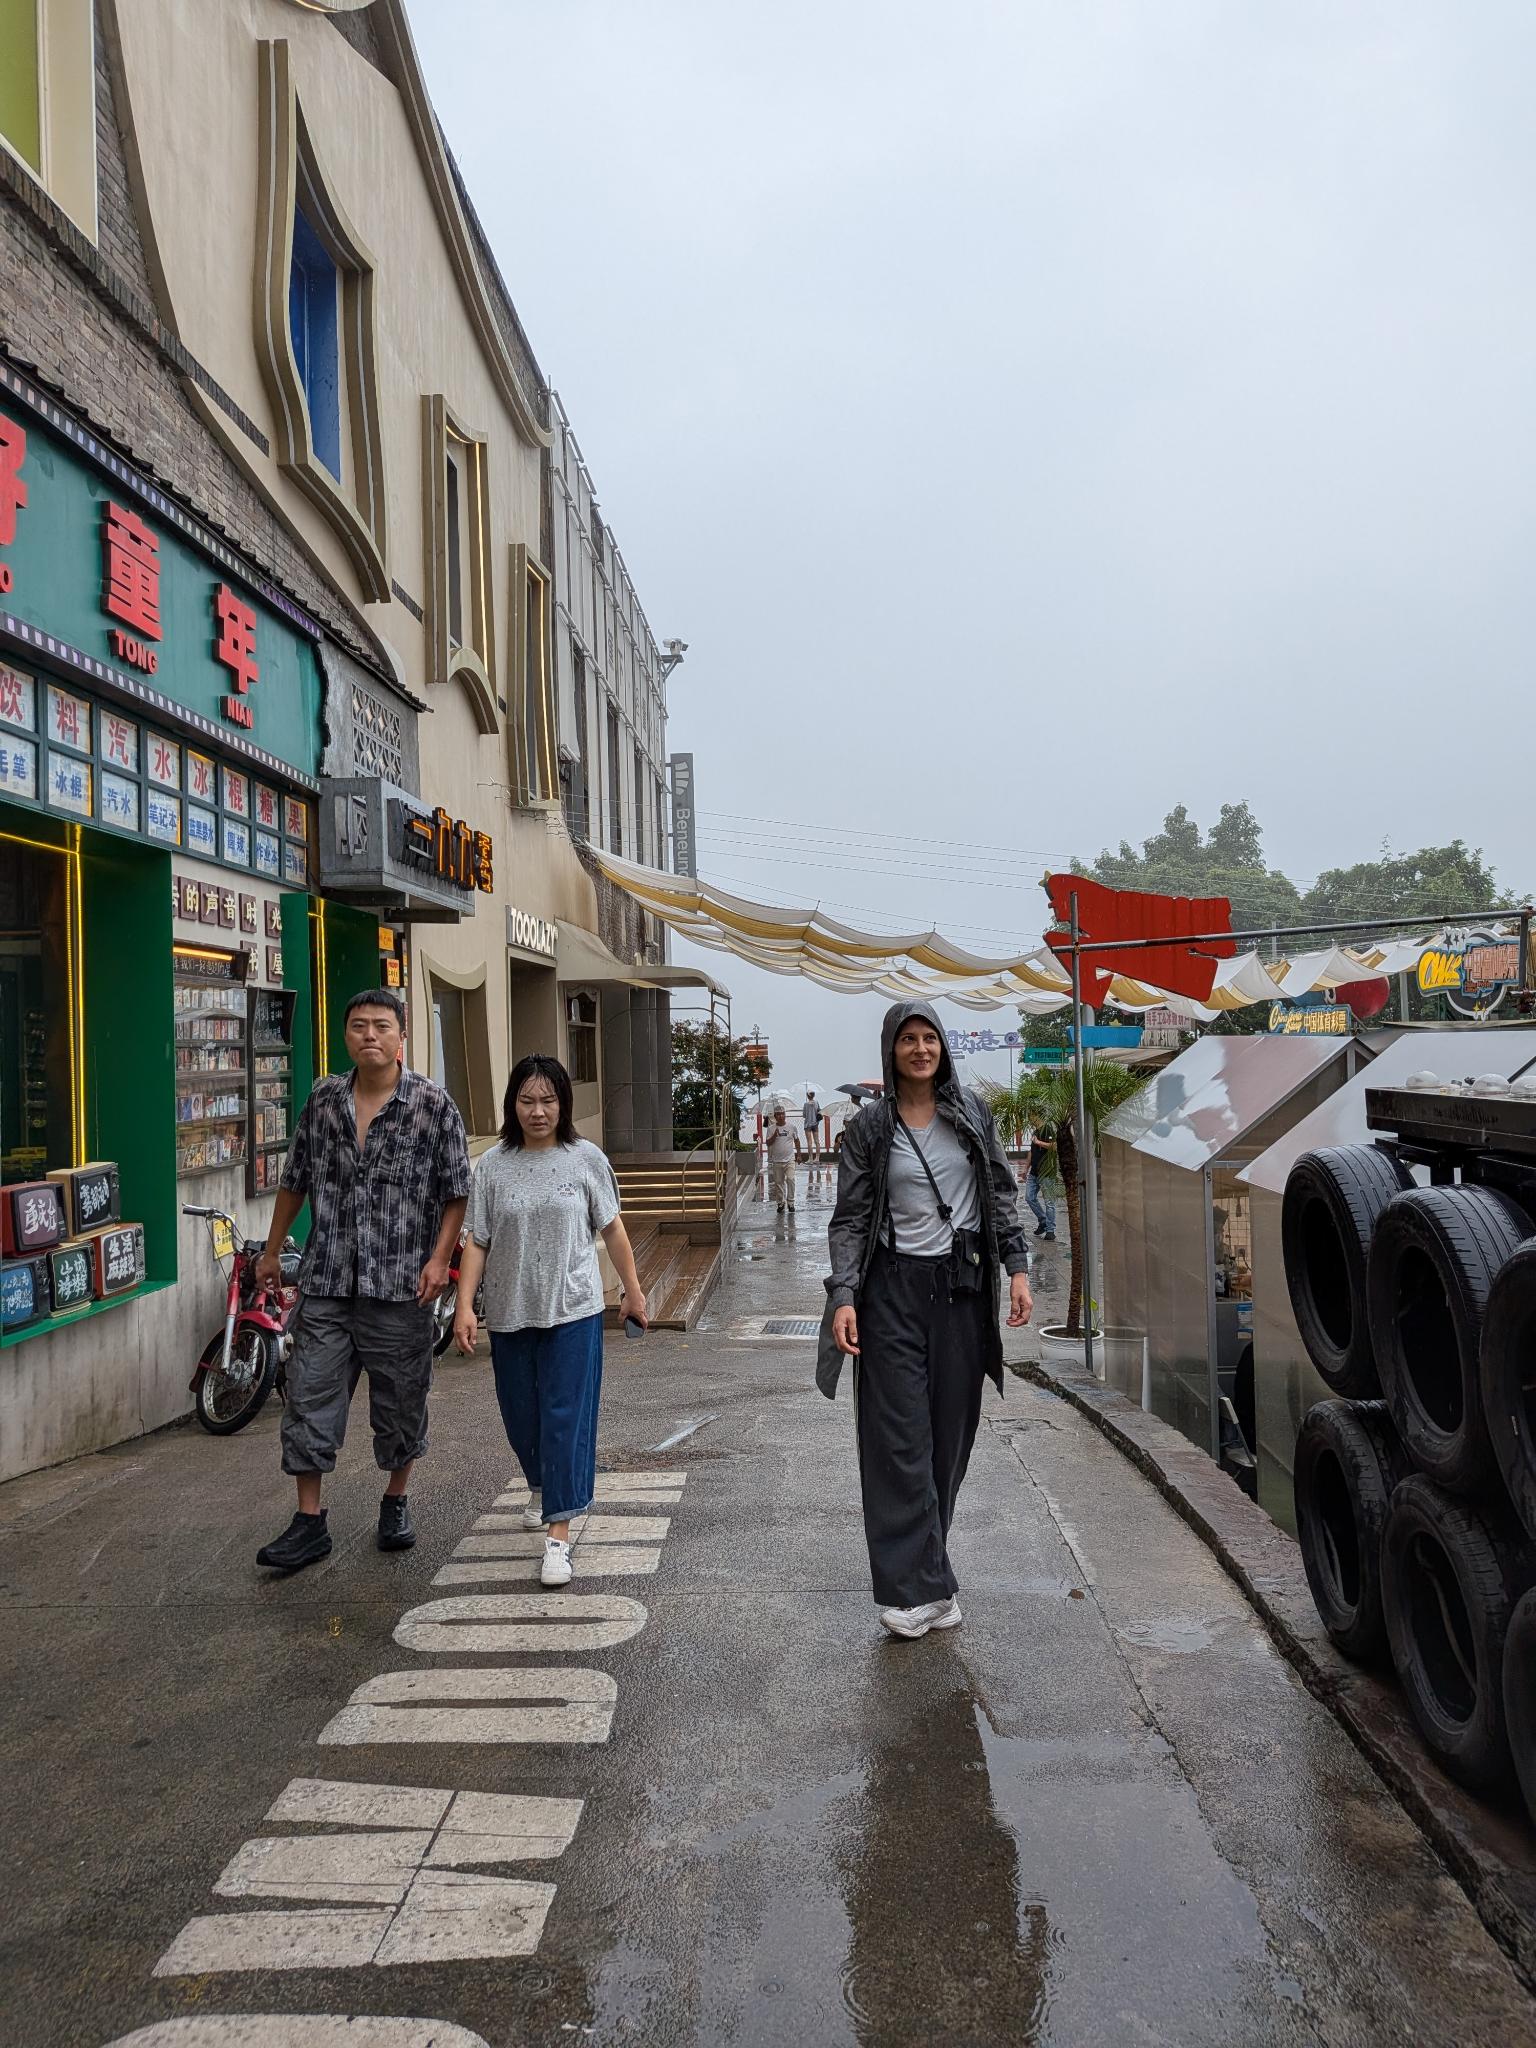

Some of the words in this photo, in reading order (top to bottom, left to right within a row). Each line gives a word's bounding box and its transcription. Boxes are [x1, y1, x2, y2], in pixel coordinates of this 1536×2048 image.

[112, 629, 159, 676] TONG
[226, 695, 254, 729] NIAN
[55, 769, 83, 799] 冰棍
[107, 788, 132, 815] 汽水
[148, 804, 177, 831] 笔记本
[1303, 1010, 1347, 1033] 中国体育彩票
[108, 1232, 133, 1260] 生活
